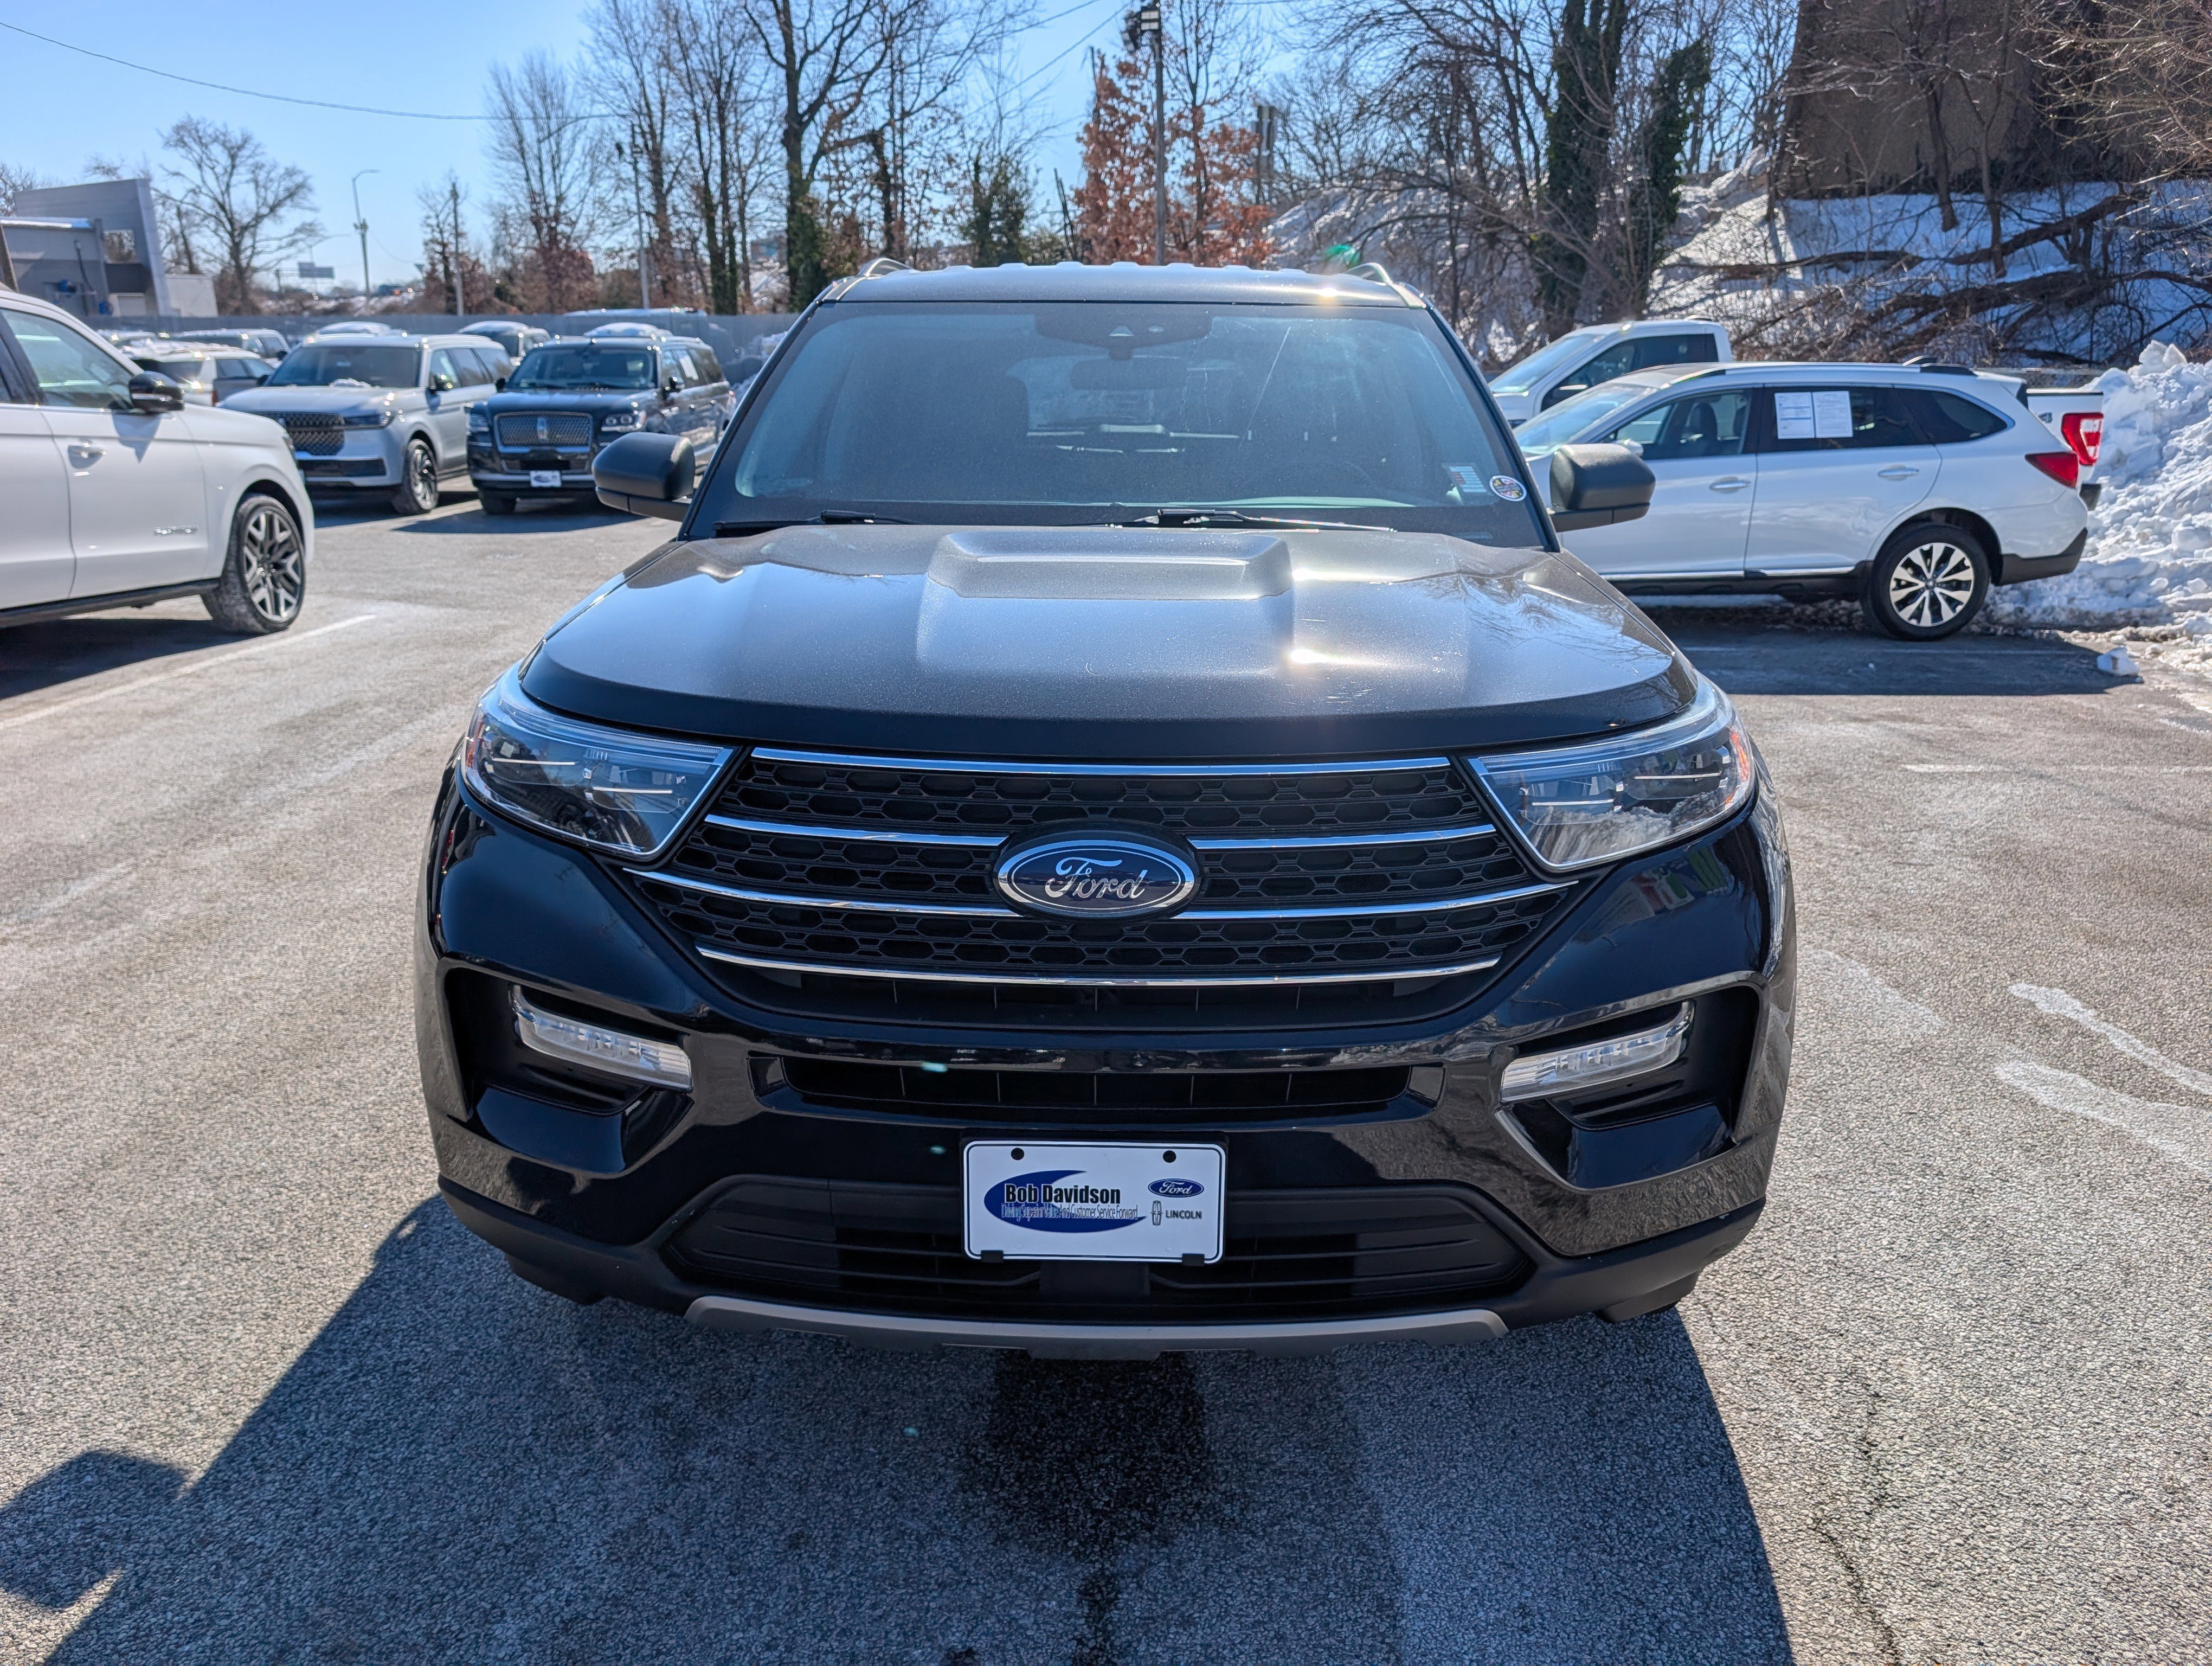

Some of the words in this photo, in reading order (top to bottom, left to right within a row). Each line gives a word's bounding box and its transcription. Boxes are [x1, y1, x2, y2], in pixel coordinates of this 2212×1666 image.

[1044, 857, 1148, 899] Ford
[1005, 1183, 1039, 1203] Bob
[1041, 1184, 1121, 1204] Davidson
[1159, 1181, 1193, 1194] Ford
[1001, 1203, 1021, 1221] Driving
[1020, 1203, 1044, 1221] Superior
[1059, 1203, 1070, 1219] And
[1071, 1203, 1096, 1219] Customer
[1097, 1204, 1116, 1219] Service
[1116, 1204, 1138, 1220] Forward
[1165, 1210, 1202, 1219] LINCOLN
